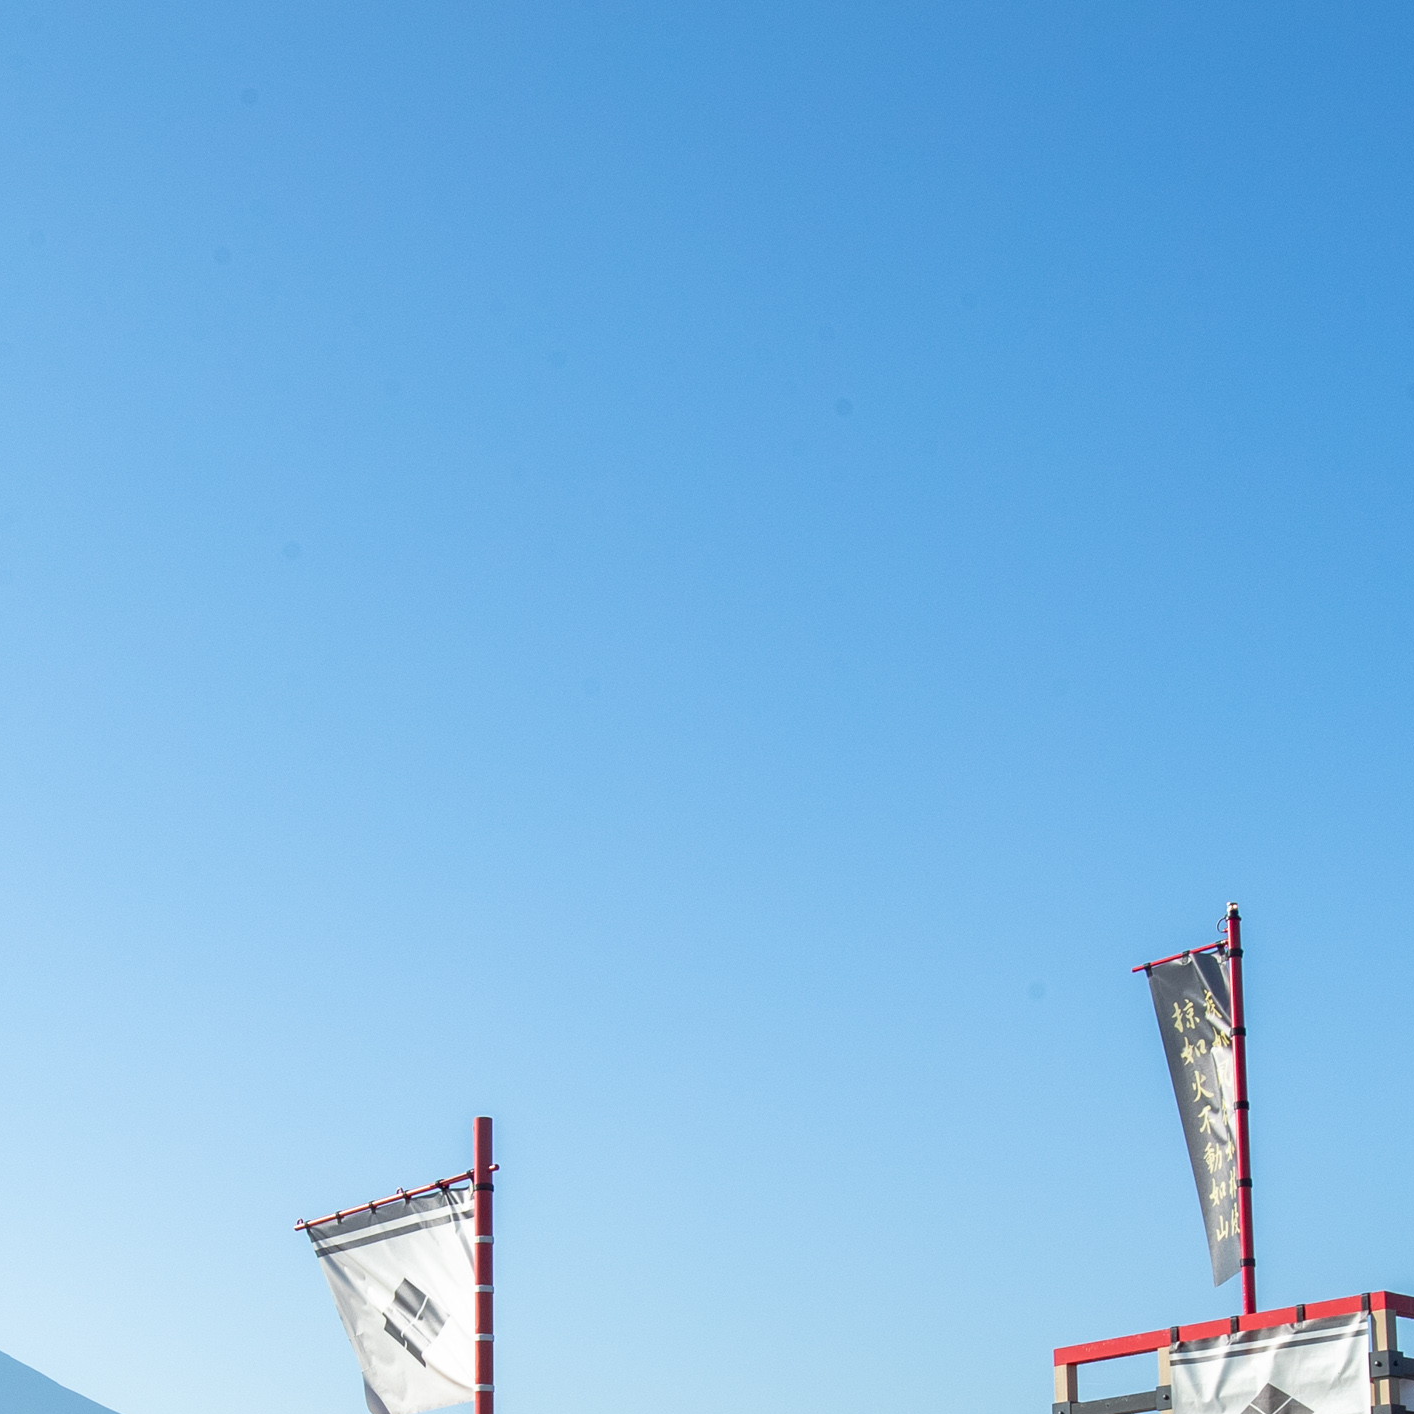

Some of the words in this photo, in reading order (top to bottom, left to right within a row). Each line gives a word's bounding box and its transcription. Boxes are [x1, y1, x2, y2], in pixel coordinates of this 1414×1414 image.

[1170, 998, 1229, 1242] 掠如火不動如山
